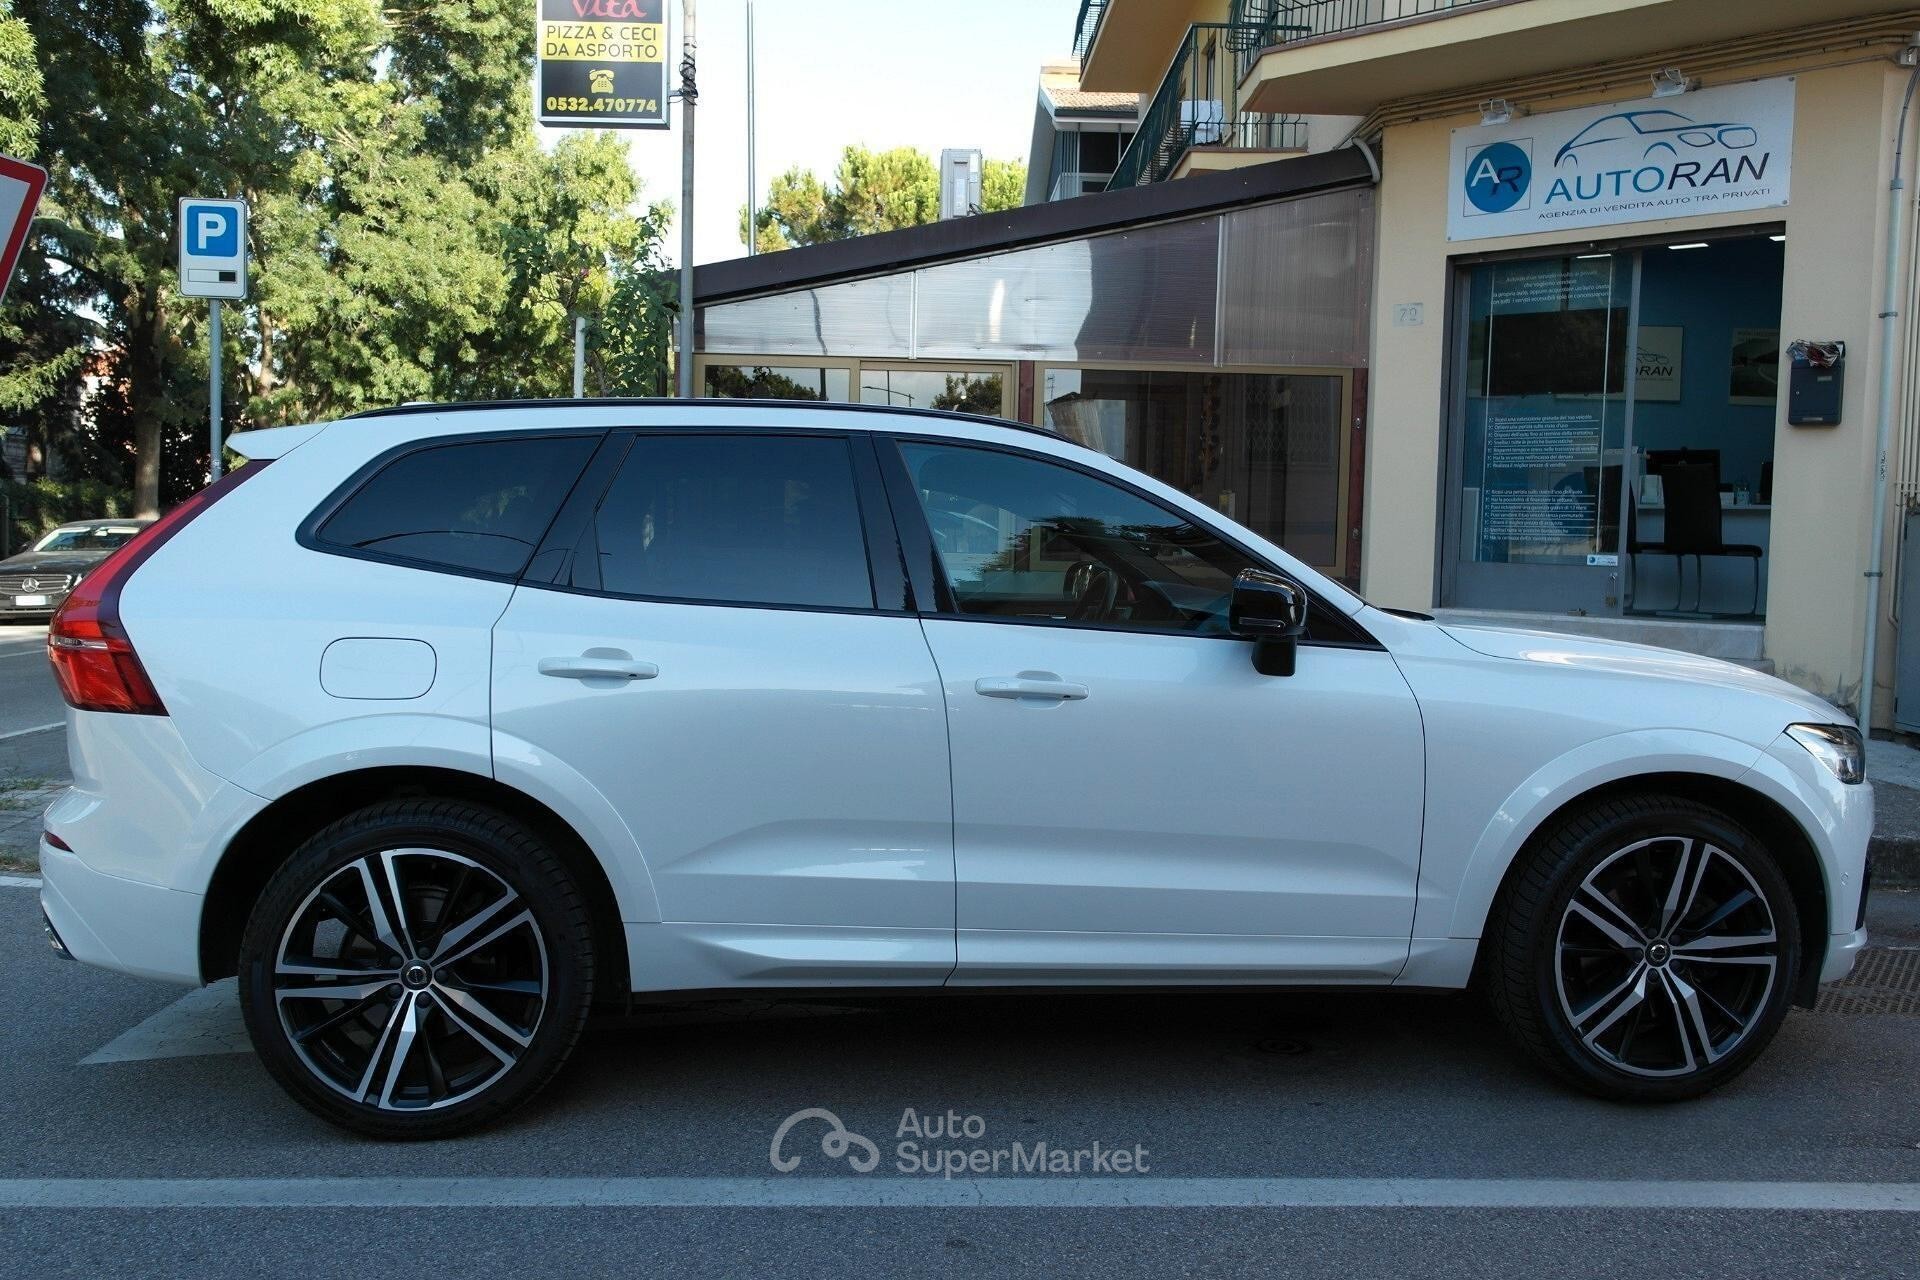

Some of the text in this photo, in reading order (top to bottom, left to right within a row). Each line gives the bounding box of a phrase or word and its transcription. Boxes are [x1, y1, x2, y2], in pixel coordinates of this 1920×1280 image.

[546, 25, 657, 41] PIZZA & CECI
[546, 42, 658, 58] DA ASPORTO
[546, 96, 658, 113] 0532.470774
[1543, 152, 1771, 205] AUTORAN
[1538, 187, 1771, 220] AGENZIA DI VENDITA AUTO TRA PRIVATI
[198, 212, 227, 250] P
